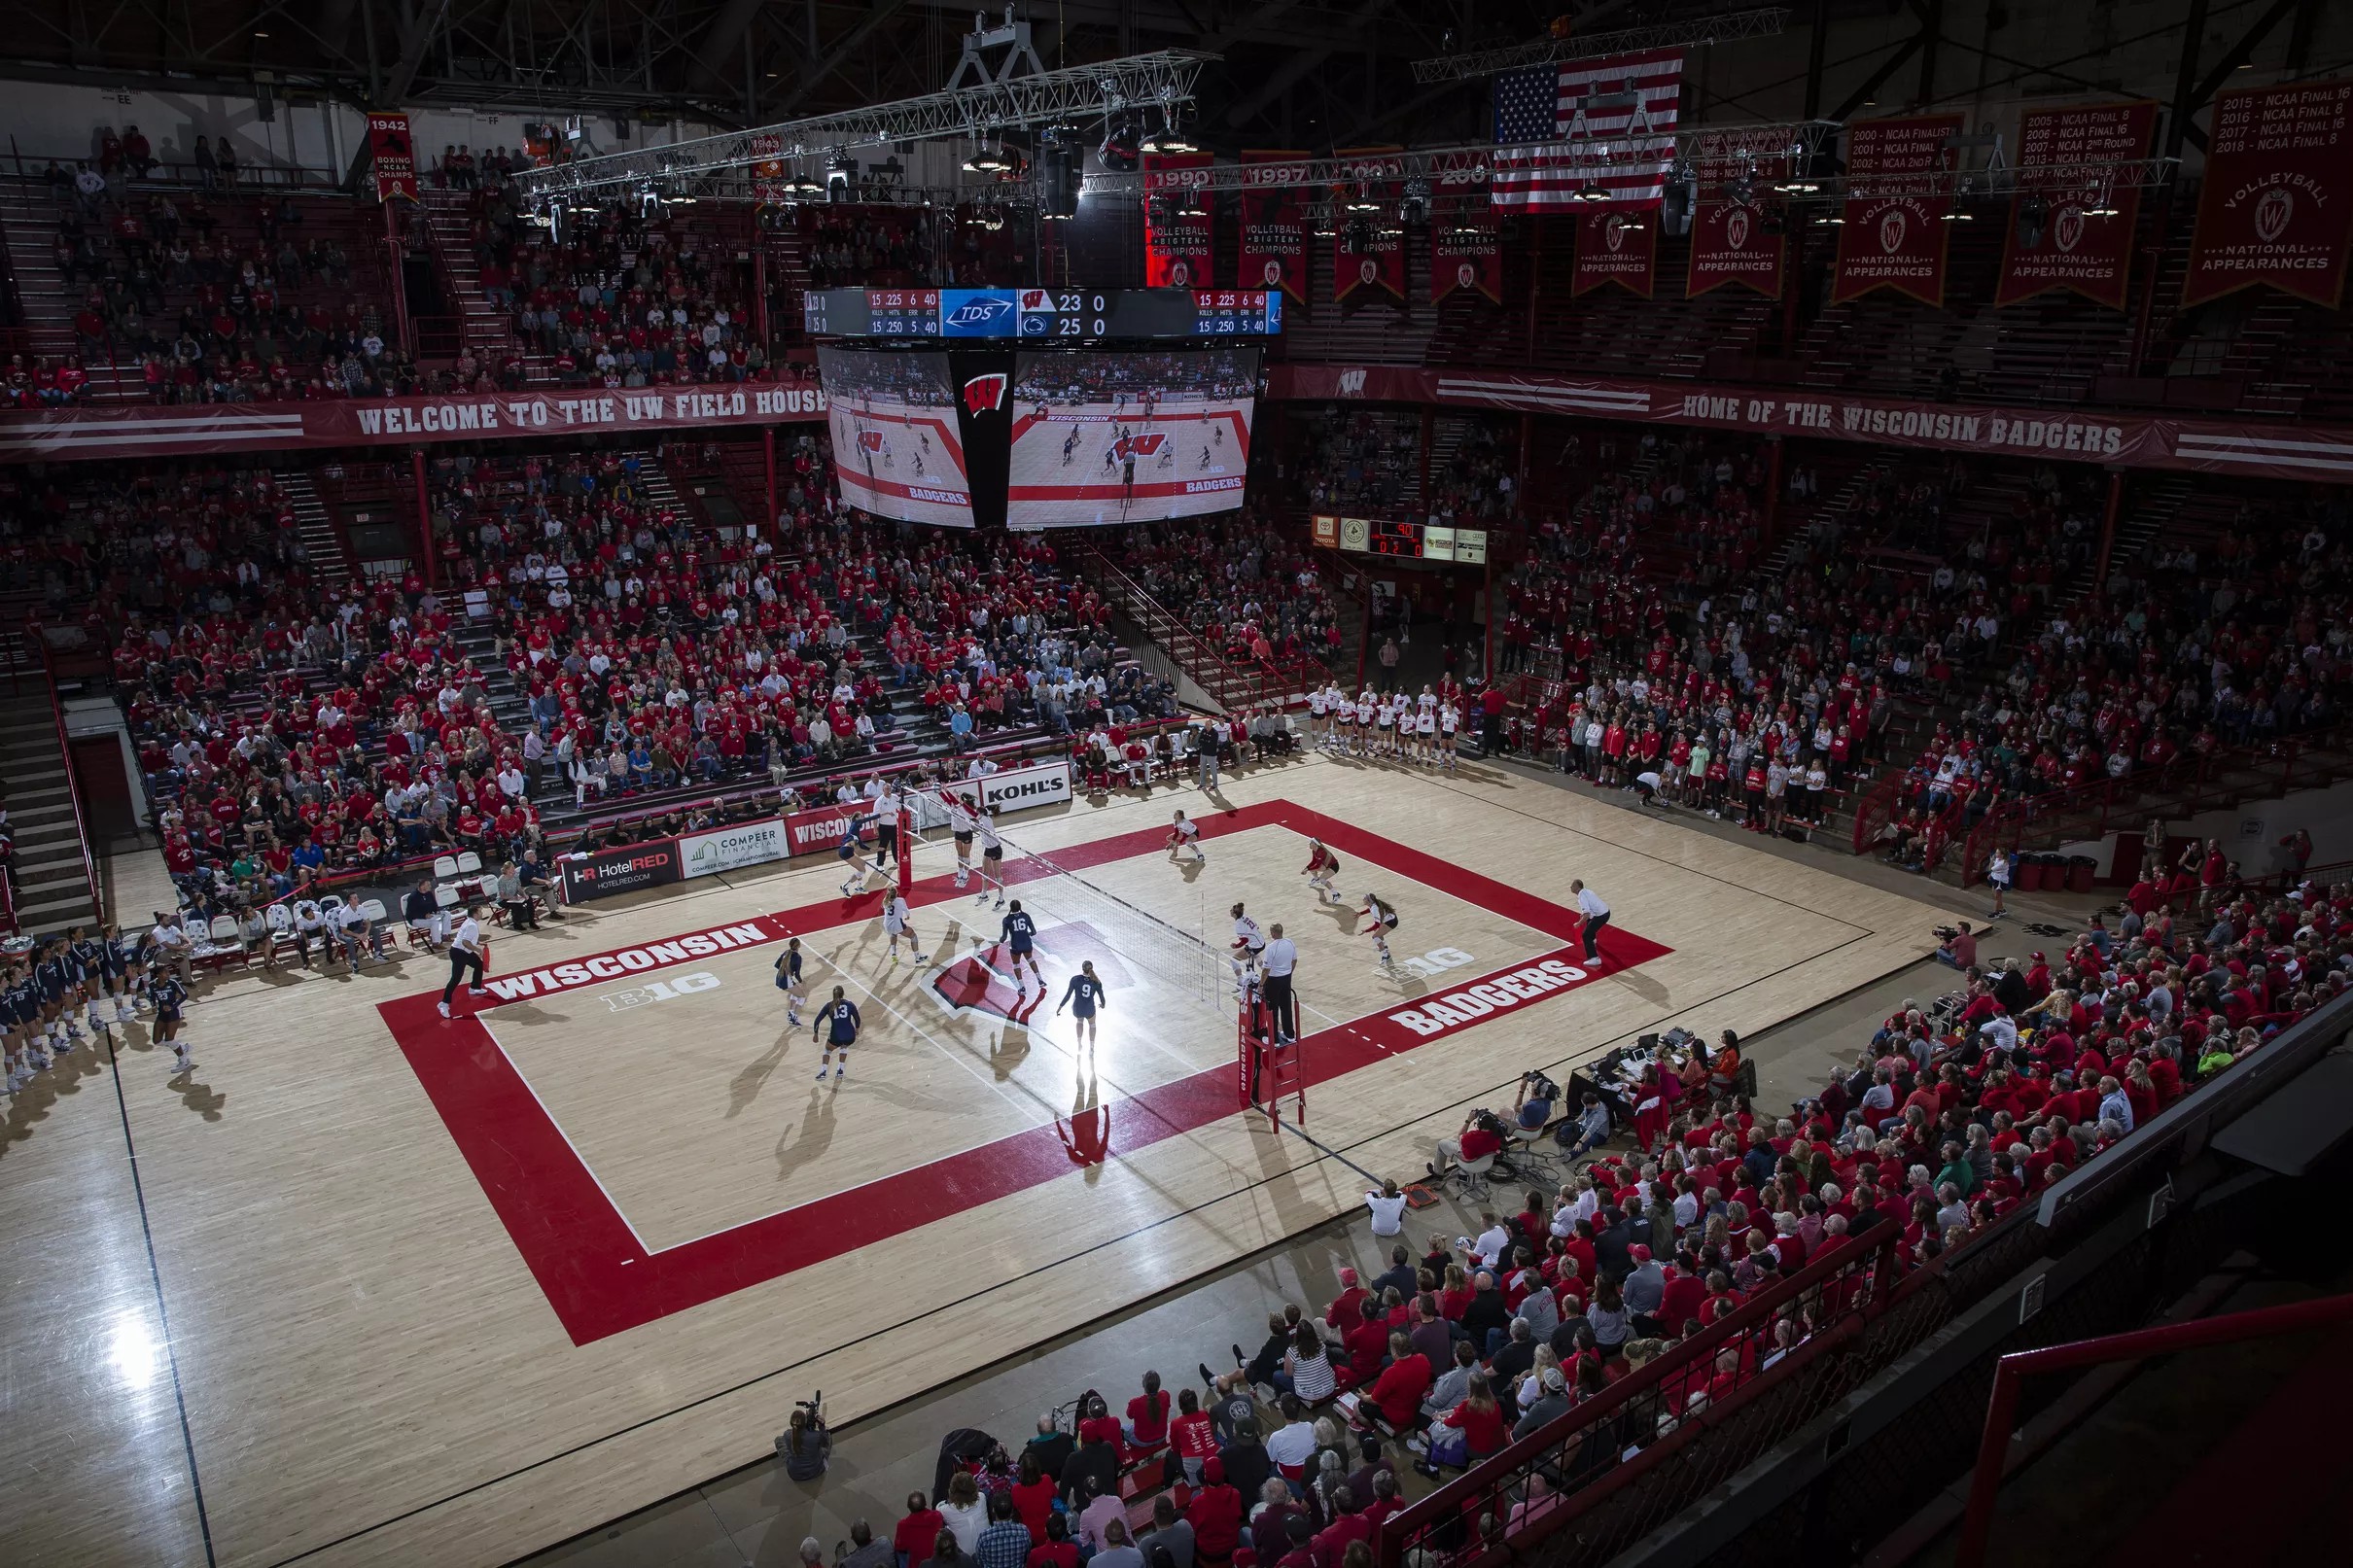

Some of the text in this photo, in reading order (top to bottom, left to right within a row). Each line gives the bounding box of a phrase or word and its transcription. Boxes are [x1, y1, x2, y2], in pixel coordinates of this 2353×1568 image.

[2223, 87, 2351, 110] 2015 NCAA FINAL 16
[2027, 110, 2130, 127] 2005 NCAA FINAL 8
[2220, 103, 2343, 124] 2016 NCAA FINAL 8
[371, 121, 407, 131] 1942
[2025, 123, 2128, 140] 2006 NCAA FINAL 16
[2218, 118, 2346, 139] 2017 NCAA FINAL 16
[1853, 130, 1878, 141] 2000
[1886, 128, 1911, 140] NCAA
[1852, 142, 1936, 156] 2001 NCAA FINAL
[2024, 142, 2049, 153] 2007
[2057, 140, 2084, 152] NCAA
[2103, 137, 2136, 149] ROUND
[2215, 132, 2337, 154] 2018 NCAA FINAL 8
[1850, 157, 1906, 169] 2002 NCAA
[2022, 151, 2125, 165] 2013 NCAA FINALIST
[1156, 170, 1209, 187] 1990
[1251, 168, 1307, 184] 1997
[2224, 171, 2330, 209] VOLLEYBALL
[1858, 195, 1931, 226] VOLLEYBALL
[1151, 226, 1209, 236] VOLLEYBALL
[1246, 225, 1303, 234] VOLLEYBALL
[1152, 247, 1208, 257] CHAMPIONS
[1245, 245, 1302, 255] CHAMPIONS
[1437, 246, 1496, 257] CHAMPIONS
[2226, 245, 2308, 255] NATIONAL
[2032, 255, 2098, 263] NATIONAL
[2201, 258, 2330, 271] APPEARANCES
[1581, 263, 1646, 272] APPEARANCES
[1698, 262, 1774, 271] APPEARANCES
[1844, 267, 1933, 277] APPEARANCES
[2013, 266, 2114, 278] APPEARANCES
[872, 294, 936, 305] 15 .225 6 40
[1060, 295, 1105, 312] 23 0
[1199, 295, 1264, 306] 15 .225 6 40
[962, 306, 993, 321] TDS
[872, 322, 936, 332] 15 .250 5 40
[1059, 319, 1106, 335] 25 0
[1199, 320, 1264, 332] 15 .250 5 40
[357, 389, 826, 436] WELCOME TO THE UW FIELD HOUSE
[1683, 395, 2124, 455] HOME OF THE WISCONSIN BADGERS
[1186, 477, 1242, 493] BADGERS
[909, 487, 967, 505] BADGERS
[1397, 524, 1413, 536] 90
[1380, 541, 1387, 553] 0
[1415, 544, 1422, 556] 0
[988, 778, 1064, 803] KOHL'S
[720, 830, 776, 849] COMPEER
[721, 840, 778, 855] FINANCIAL
[573, 854, 669, 884] HR HotelRED
[692, 861, 730, 873] COMPEER.COM
[597, 873, 650, 889] HOTELRED.COM
[888, 905, 896, 916] 3
[1012, 917, 1027, 932] 16
[484, 923, 770, 1000] WISCONSIN
[1081, 984, 1091, 998] 9
[1388, 958, 1588, 1037] BADGERS
[833, 1004, 848, 1020] 13
